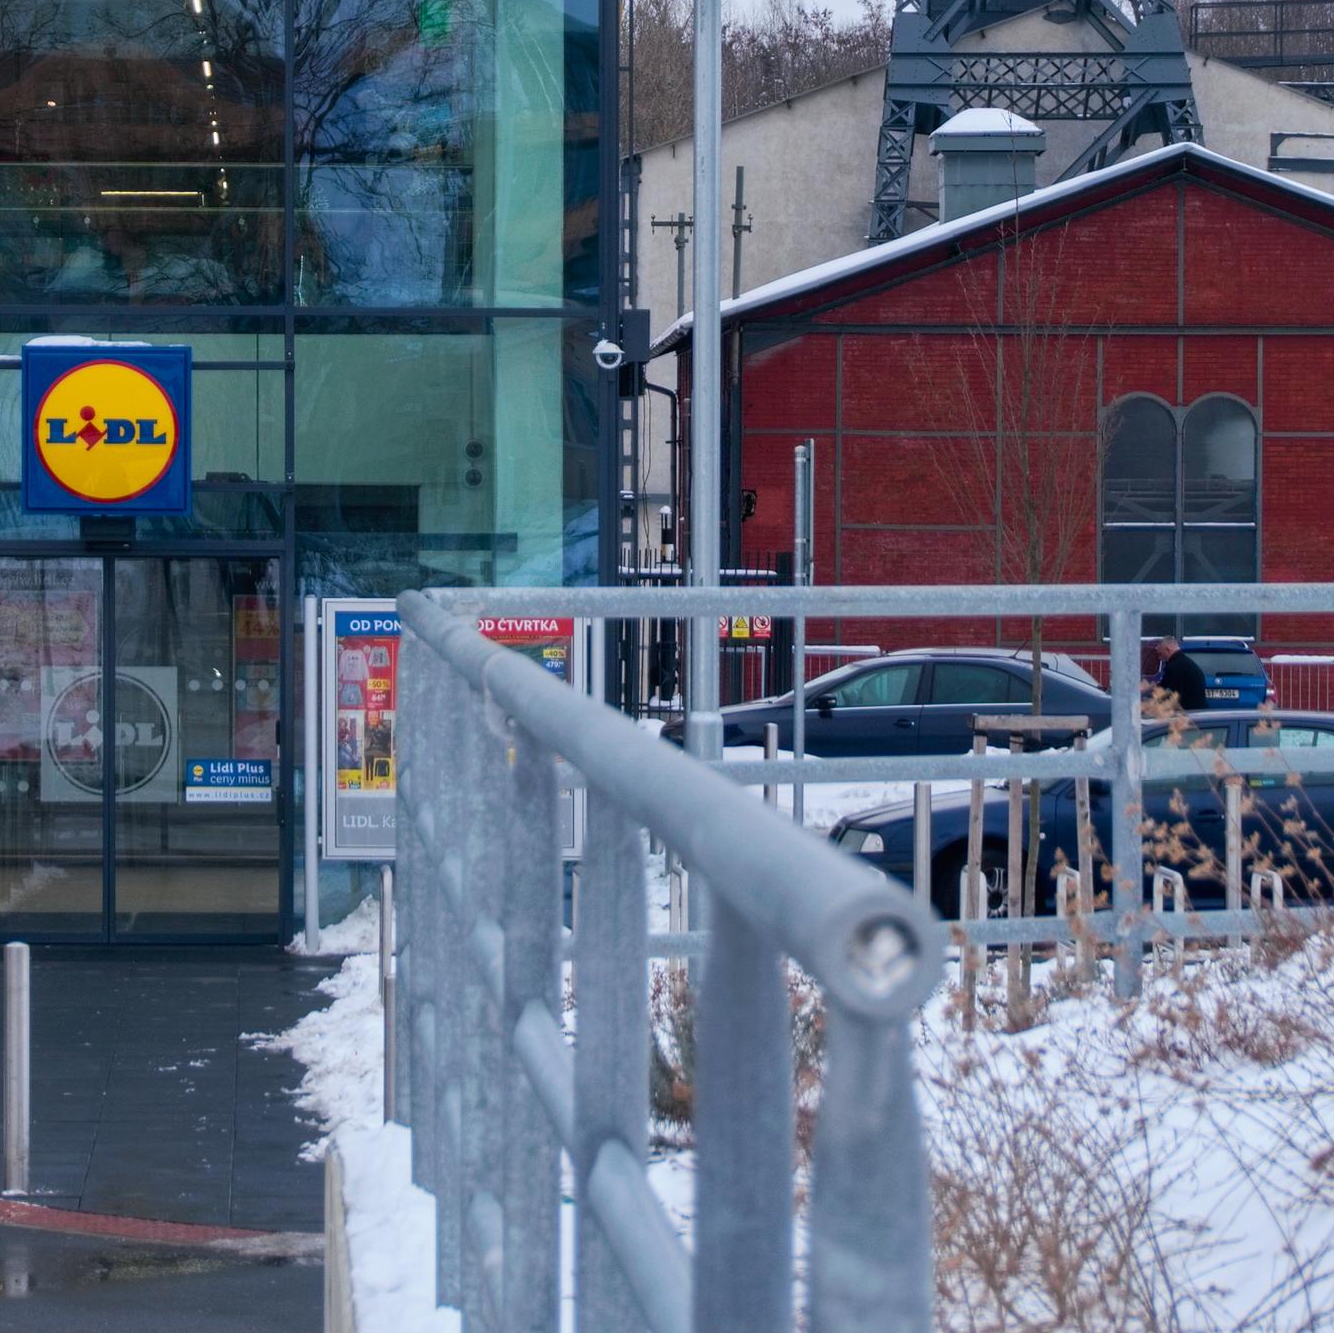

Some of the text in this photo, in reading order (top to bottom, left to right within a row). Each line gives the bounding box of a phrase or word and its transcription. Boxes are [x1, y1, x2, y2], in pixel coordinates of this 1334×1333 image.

[46, 406, 167, 451] LIDL
[349, 619, 371, 632] OD
[497, 617, 559, 632] ČTVRTKA
[210, 762, 234, 773] Lidl
[237, 762, 265, 773] Plus
[210, 774, 270, 785] ceny minus
